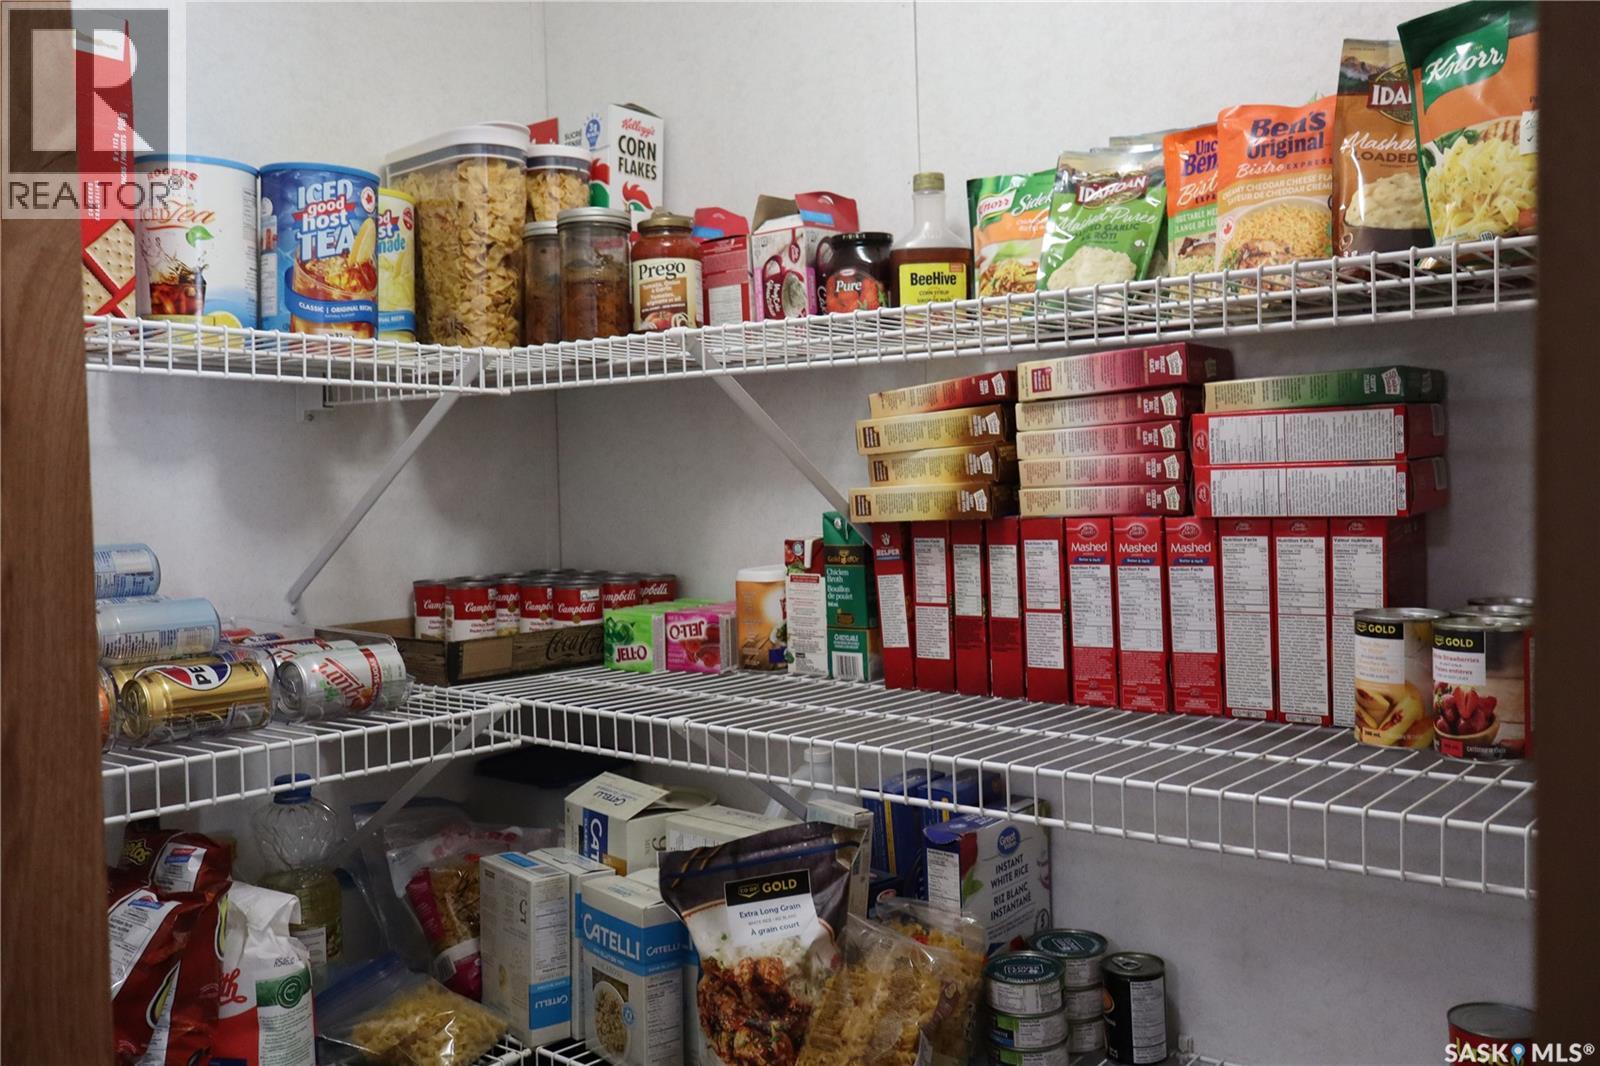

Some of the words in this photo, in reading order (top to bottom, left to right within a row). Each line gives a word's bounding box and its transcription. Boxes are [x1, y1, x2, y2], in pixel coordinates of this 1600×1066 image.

[1423, 47, 1502, 84] Knorr
[621, 118, 655, 138] Kellogg's
[1250, 112, 1326, 138] Ben's
[618, 135, 656, 161] CORN
[1195, 140, 1217, 155] Unc
[1247, 132, 1324, 160] Original
[147, 168, 198, 181] ROGERS
[618, 157, 657, 180] FLAKES
[1235, 162, 1285, 178] Bistro
[1078, 176, 1147, 203] IDAHOAN
[1247, 180, 1285, 192] CHEDDAR
[1286, 176, 1317, 187] CHEESE
[298, 179, 353, 209] ICED
[1266, 187, 1305, 199] CHEDDAR
[160, 199, 216, 224] Tea
[307, 197, 345, 216] good
[978, 197, 1009, 214] Knorr
[302, 210, 349, 233] host
[300, 227, 351, 261] TEA
[639, 262, 685, 280] Prego
[910, 271, 956, 286] BeeHive
[836, 280, 863, 293] Pure
[298, 302, 325, 313] CLASSIC
[331, 305, 359, 313] ORIGINAL
[1071, 542, 1107, 552] Mashed
[1119, 543, 1157, 553] Mashed
[1170, 543, 1211, 553] Mashed
[826, 568, 849, 576] Chicken
[827, 575, 843, 583] Broth
[827, 585, 850, 593] Bouillon
[836, 593, 853, 601] poulet
[669, 621, 705, 640] JELL-O
[1368, 624, 1396, 634] GOLD
[1445, 637, 1474, 648] GOLD
[616, 646, 648, 663] JELL-O
[995, 854, 1024, 874] INSTANT
[991, 874, 1013, 889] WHITE
[1014, 864, 1029, 879] RICE
[762, 878, 797, 893] GOLD
[993, 893, 1005, 906] RIZ
[1007, 881, 1028, 900] BLANC
[739, 910, 758, 919] Extra
[760, 907, 779, 916] Long
[780, 903, 801, 912] Grain
[991, 890, 1032, 921] INSTANTANÉ
[583, 912, 640, 961] CATELLI
[758, 926, 778, 936] grain
[779, 921, 800, 930] court
[646, 943, 680, 957] CATELLI
